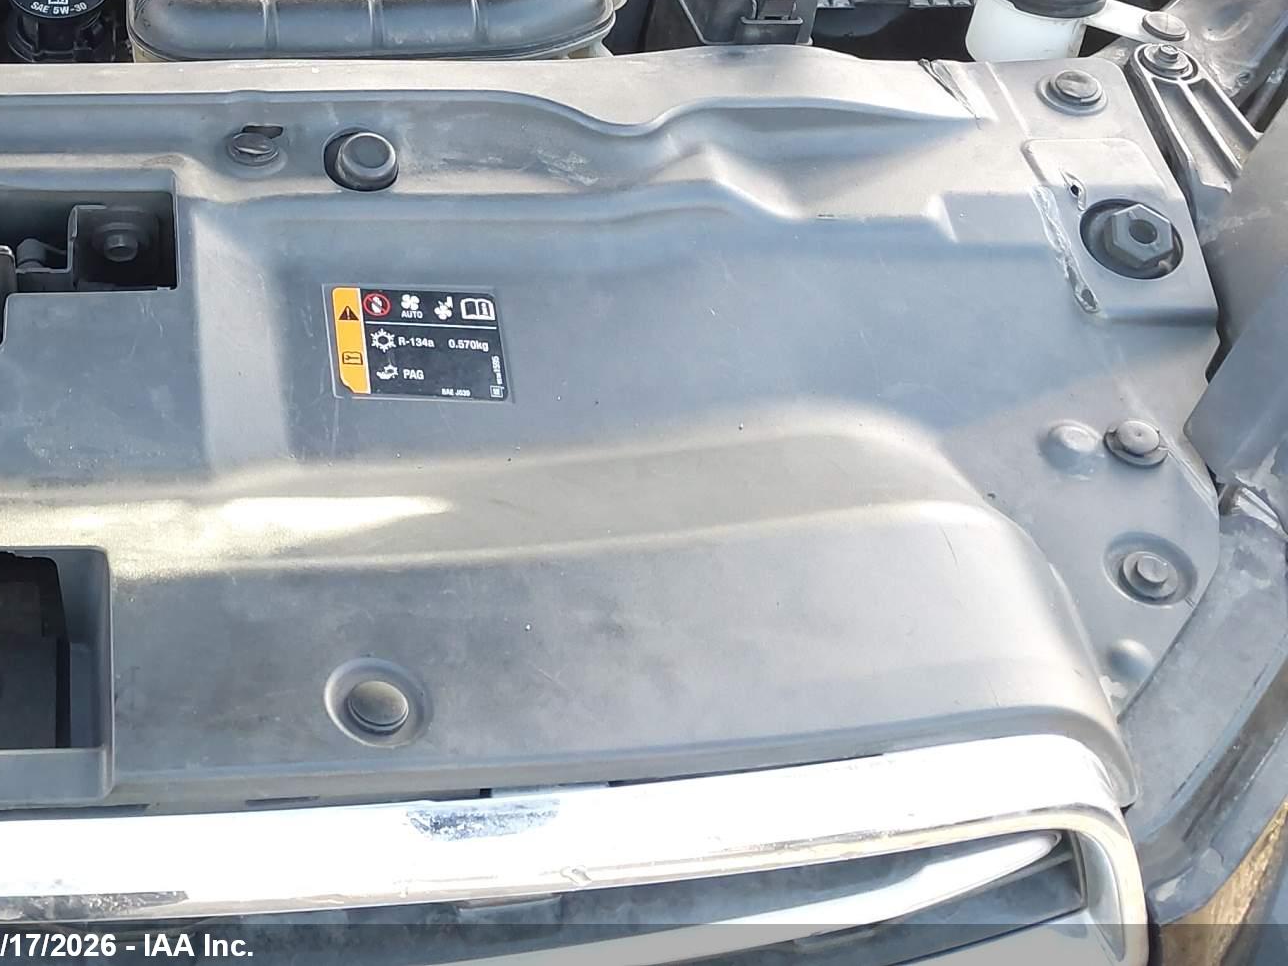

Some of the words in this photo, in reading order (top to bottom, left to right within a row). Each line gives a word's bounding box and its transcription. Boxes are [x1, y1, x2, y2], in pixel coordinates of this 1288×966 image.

[31, 1, 50, 13] SAE
[53, 2, 87, 14] 5W-30
[401, 311, 423, 319] AUTO
[398, 336, 435, 348] R-134a
[448, 339, 489, 352] 0.570kg
[403, 369, 424, 380] PAG
